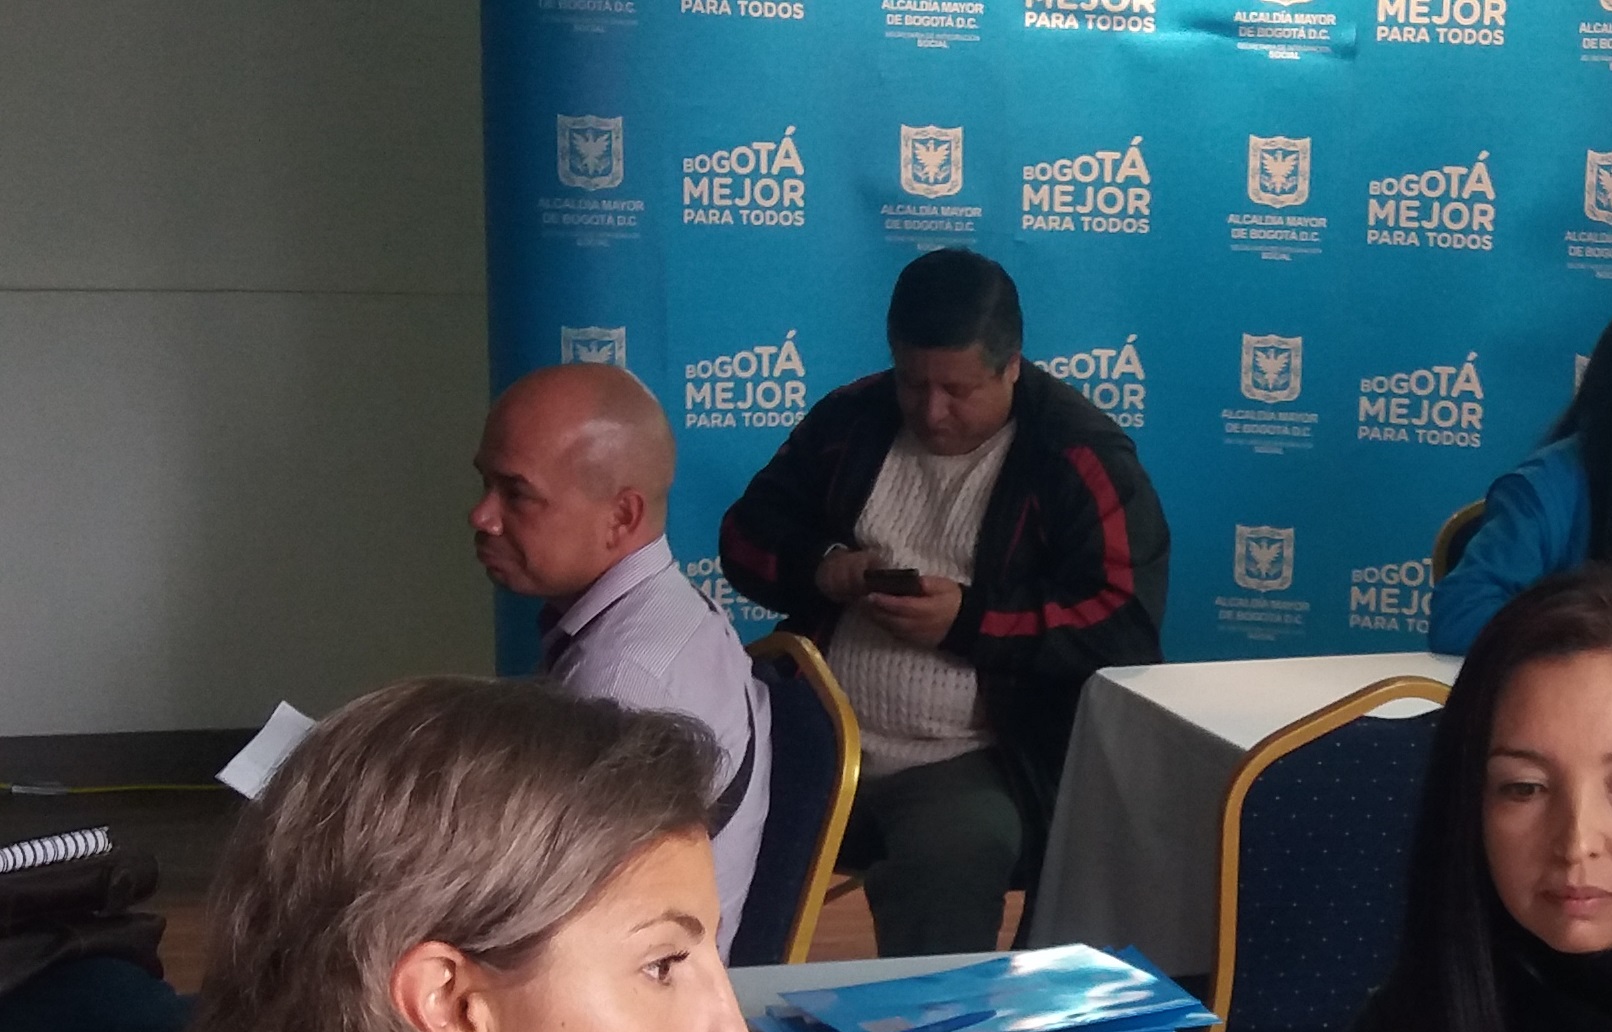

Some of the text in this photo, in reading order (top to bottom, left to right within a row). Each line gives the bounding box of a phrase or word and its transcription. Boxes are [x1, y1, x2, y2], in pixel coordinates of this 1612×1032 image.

[681, 0, 805, 19] PARA TODOS
[941, 1, 984, 14] MAYOR
[1234, 10, 1336, 25] ALCALDÍA MAYOR
[1377, 0, 1506, 26] MEJOR
[886, 14, 902, 25] DE
[903, 13, 953, 28] BOGOTÁ
[1024, 11, 1157, 33] PARA TODOS
[1239, 27, 1256, 37] DE
[1257, 26, 1305, 40] BOGOTÁ
[1376, 25, 1505, 45] PARA TODOS
[1582, 38, 1599, 49] DE
[682, 125, 805, 175] BOGOTÁ
[1022, 135, 1151, 185] BOGOTÁ
[1368, 150, 1496, 200] BOGOTÁ
[682, 177, 805, 207] MEJOR
[1022, 184, 1151, 215] MEJOR
[602, 199, 644, 212] MAYOR
[1368, 199, 1496, 231] MEJOR
[683, 209, 805, 226] PARA TODOS
[1022, 216, 1150, 234] PARA TODOS
[1231, 228, 1248, 239] DE
[1367, 230, 1493, 250] PARA TODOS
[685, 329, 806, 379] BOGOTÁ
[1033, 333, 1146, 380] GOTÁ
[1360, 351, 1484, 400] BOGOTÁ
[685, 381, 806, 410] MEJOR
[686, 412, 736, 428] PARA
[1358, 396, 1484, 430] MEJOR
[1357, 426, 1481, 448] PARA TODOS
[1351, 558, 1433, 588] BOGOT
[1350, 614, 1399, 631] PARA
